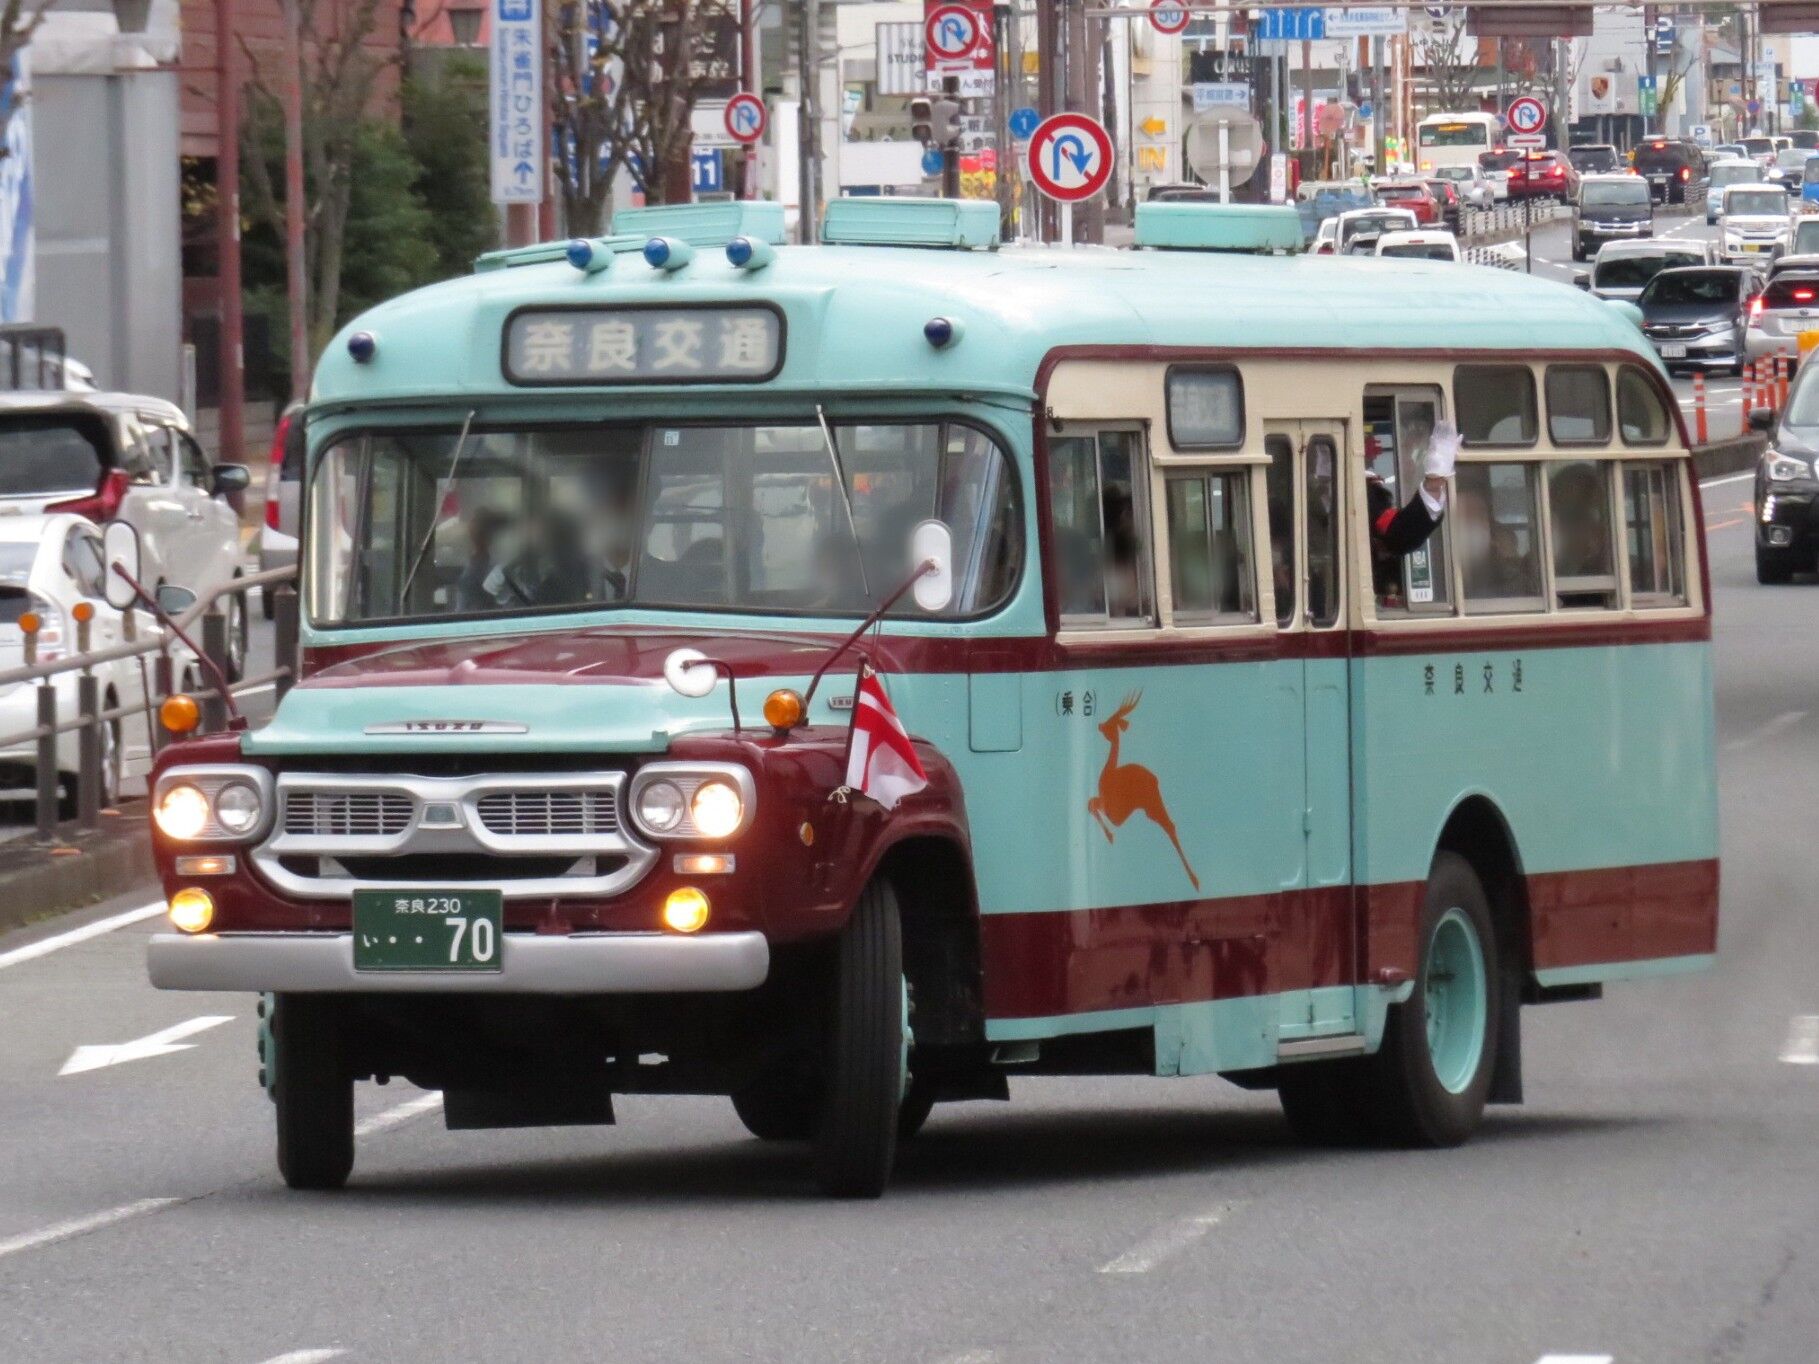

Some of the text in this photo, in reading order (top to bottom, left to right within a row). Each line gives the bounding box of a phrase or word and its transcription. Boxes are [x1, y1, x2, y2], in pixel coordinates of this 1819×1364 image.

[1138, 146, 1166, 170] IN
[523, 316, 770, 372] 奈良交通
[1423, 658, 1523, 696] 奈良交通
